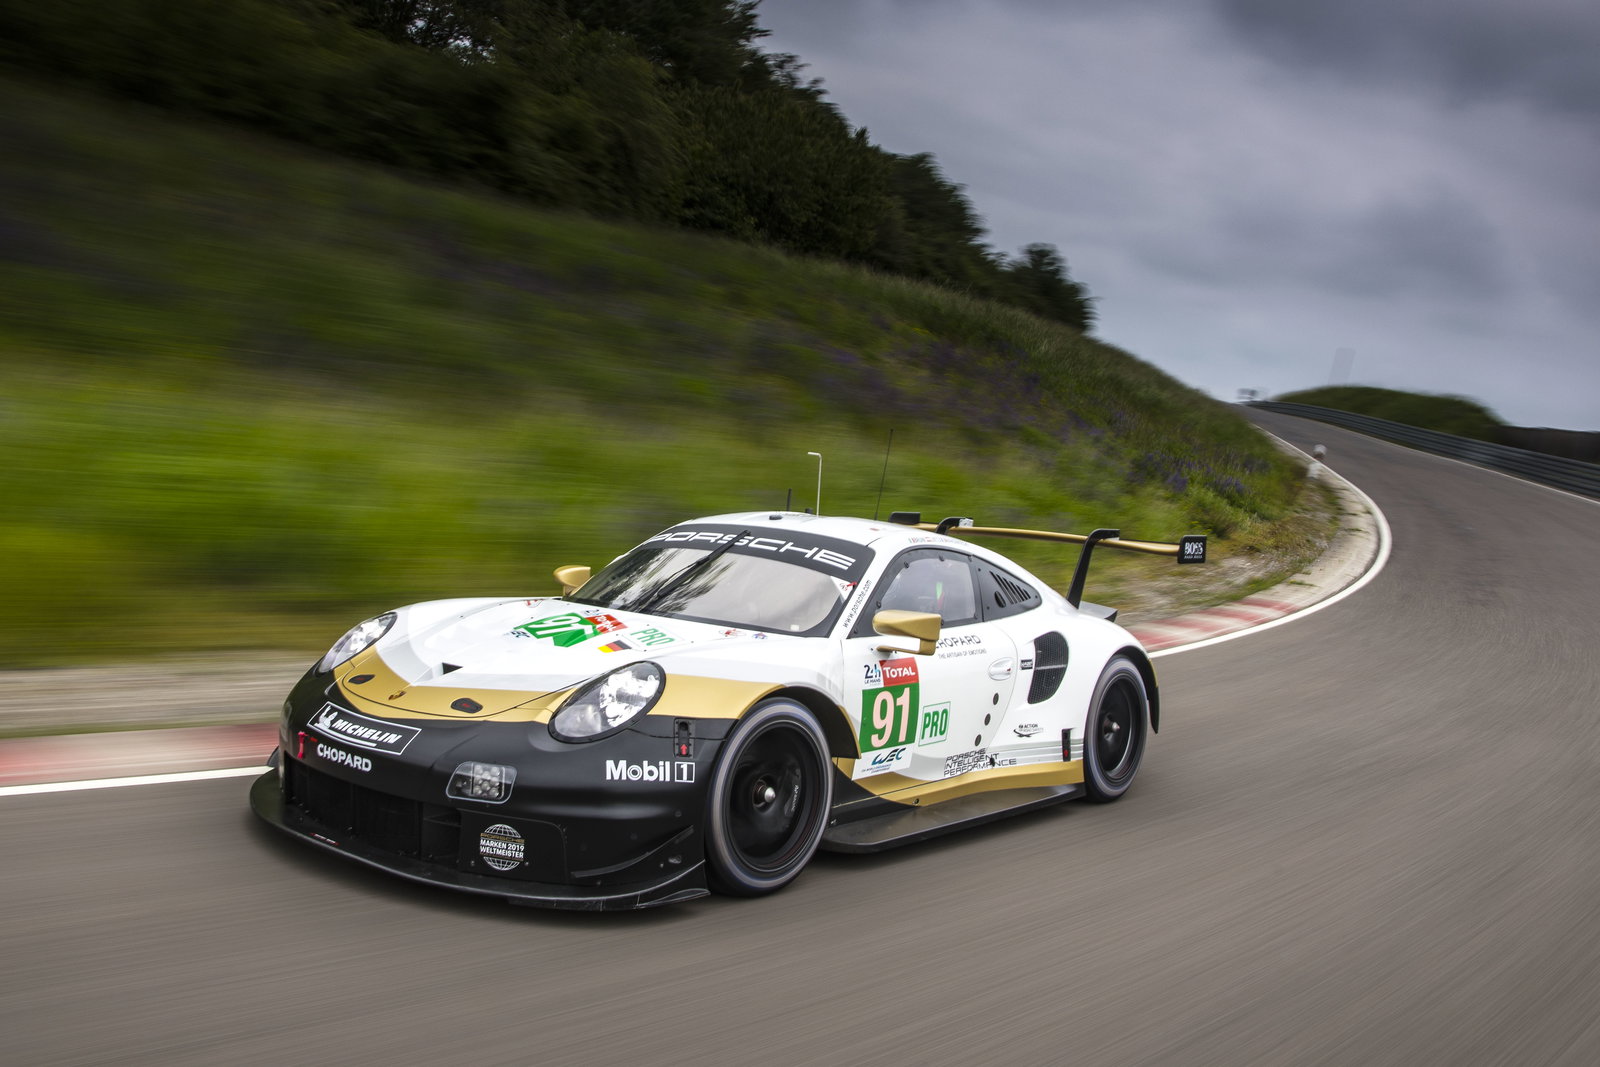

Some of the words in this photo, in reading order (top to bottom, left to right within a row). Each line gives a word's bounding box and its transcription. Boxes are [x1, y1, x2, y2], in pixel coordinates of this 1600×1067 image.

[650, 531, 856, 570] PORSCHE
[1184, 542, 1204, 555] BOSS
[842, 579, 872, 628] www.porsche.com
[630, 628, 675, 646] PRO
[936, 635, 981, 648] HOPARD
[870, 687, 911, 748] 91
[921, 708, 949, 740] PRO
[332, 719, 402, 744] MICHELIN
[317, 743, 372, 772] CHOPARD
[871, 747, 907, 766] WEC
[944, 753, 999, 770] INTELLIGENT
[945, 748, 986, 763] PORSCHE
[605, 759, 670, 782] Mobil
[480, 839, 507, 849] MARKEN
[507, 843, 525, 852] 2019
[480, 846, 524, 859] WELTMEISTER
